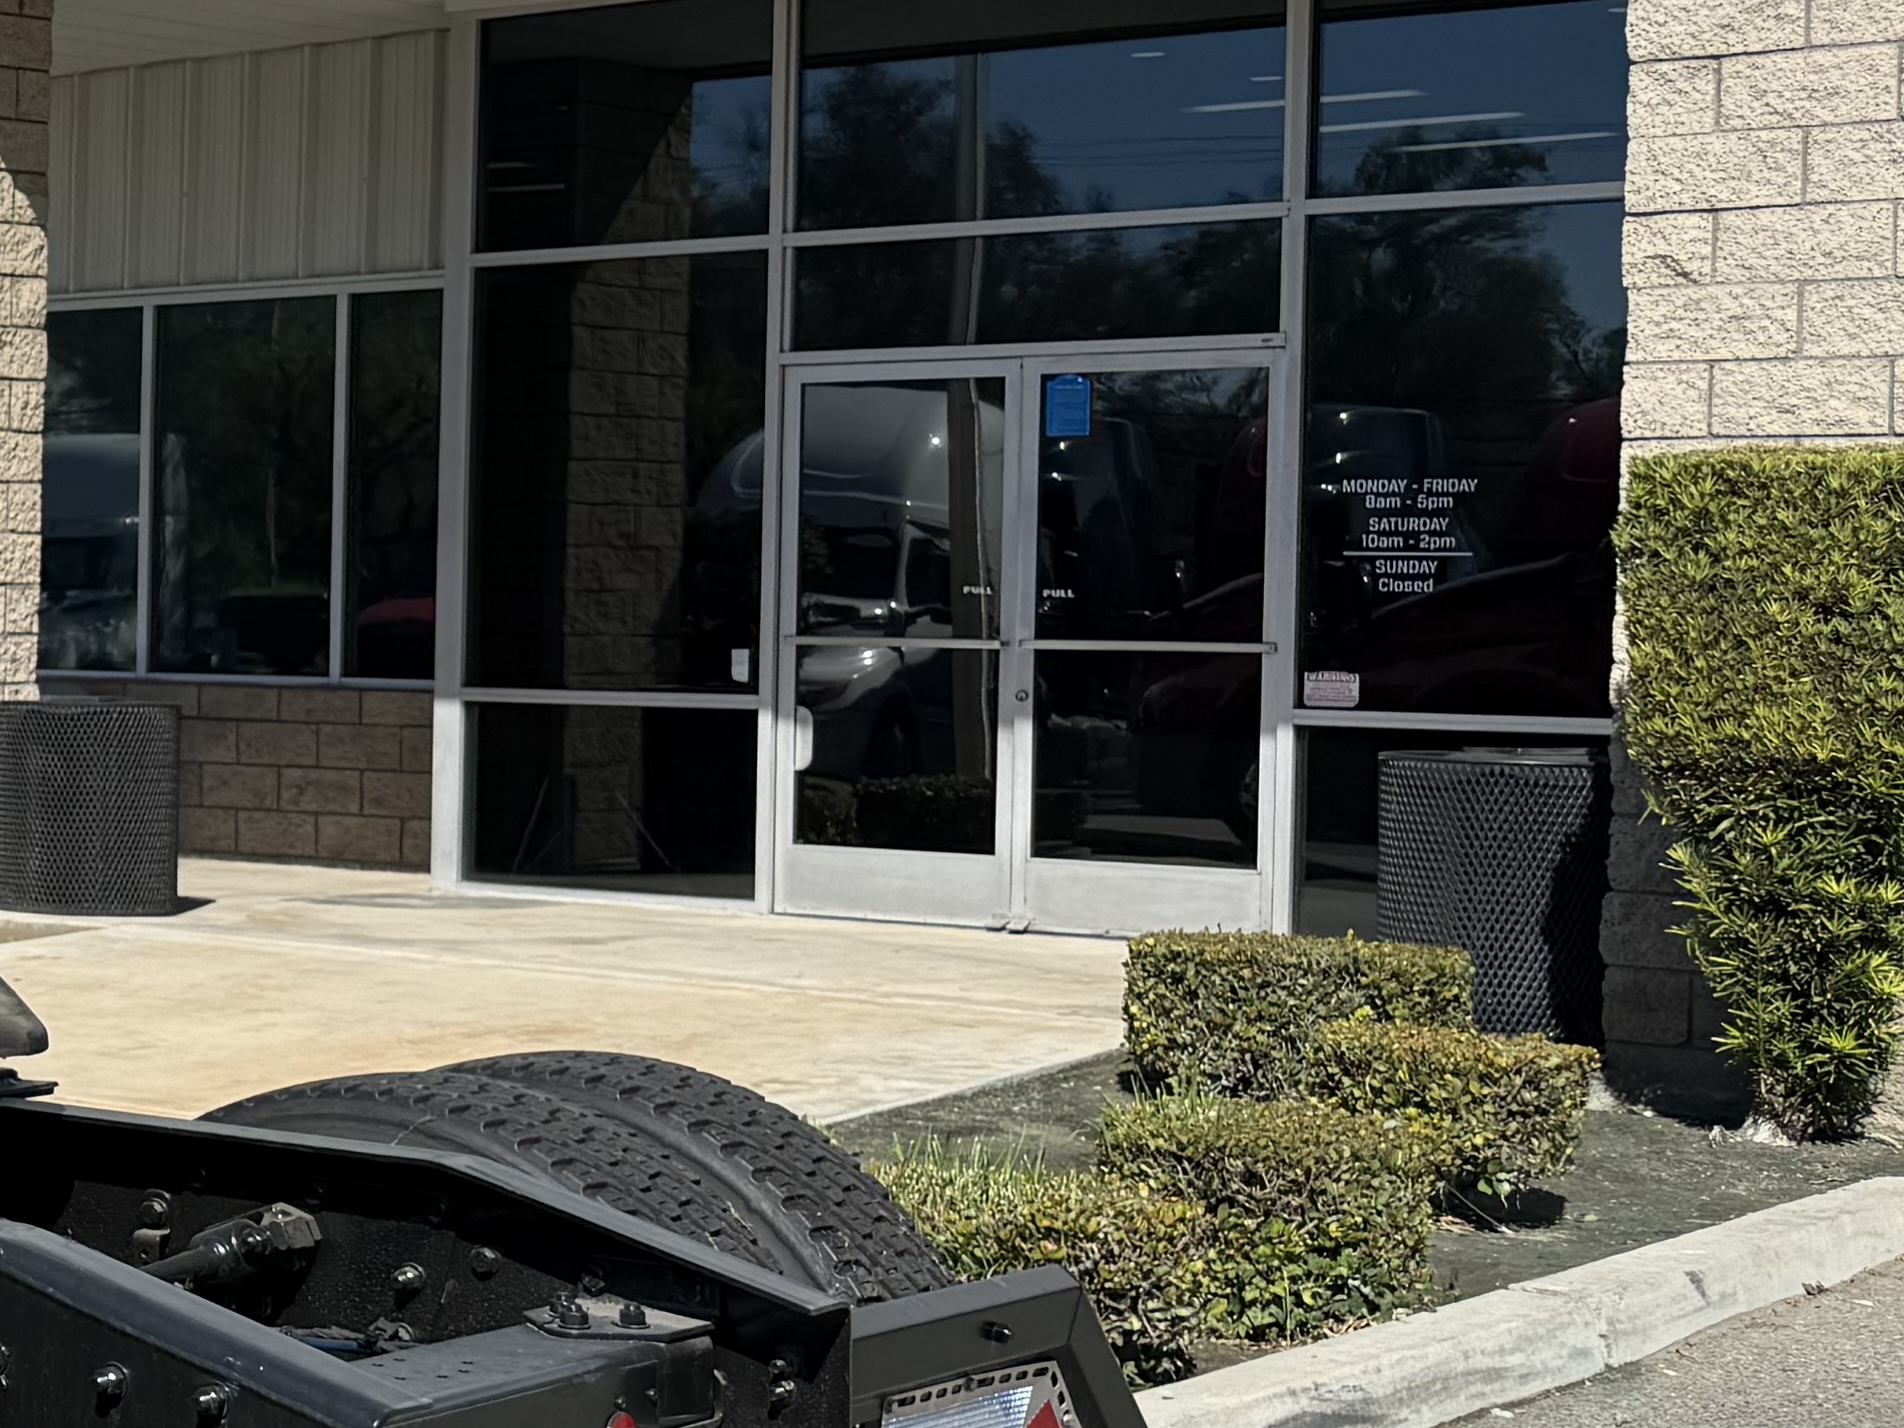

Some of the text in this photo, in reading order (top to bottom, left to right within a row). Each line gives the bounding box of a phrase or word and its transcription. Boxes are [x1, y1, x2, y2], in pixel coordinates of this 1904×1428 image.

[1342, 478, 1408, 493] MONDAY
[1423, 478, 1479, 493] FRIDAY
[1365, 494, 1401, 509] 8am
[1417, 494, 1454, 511] 5pm
[1368, 517, 1450, 532] SATURDAY
[1362, 533, 1404, 548] 10am
[1419, 533, 1456, 550] 2pm
[1375, 559, 1438, 574] SUNDAY
[1378, 578, 1434, 592] Closed
[1042, 588, 1075, 598] PULL
